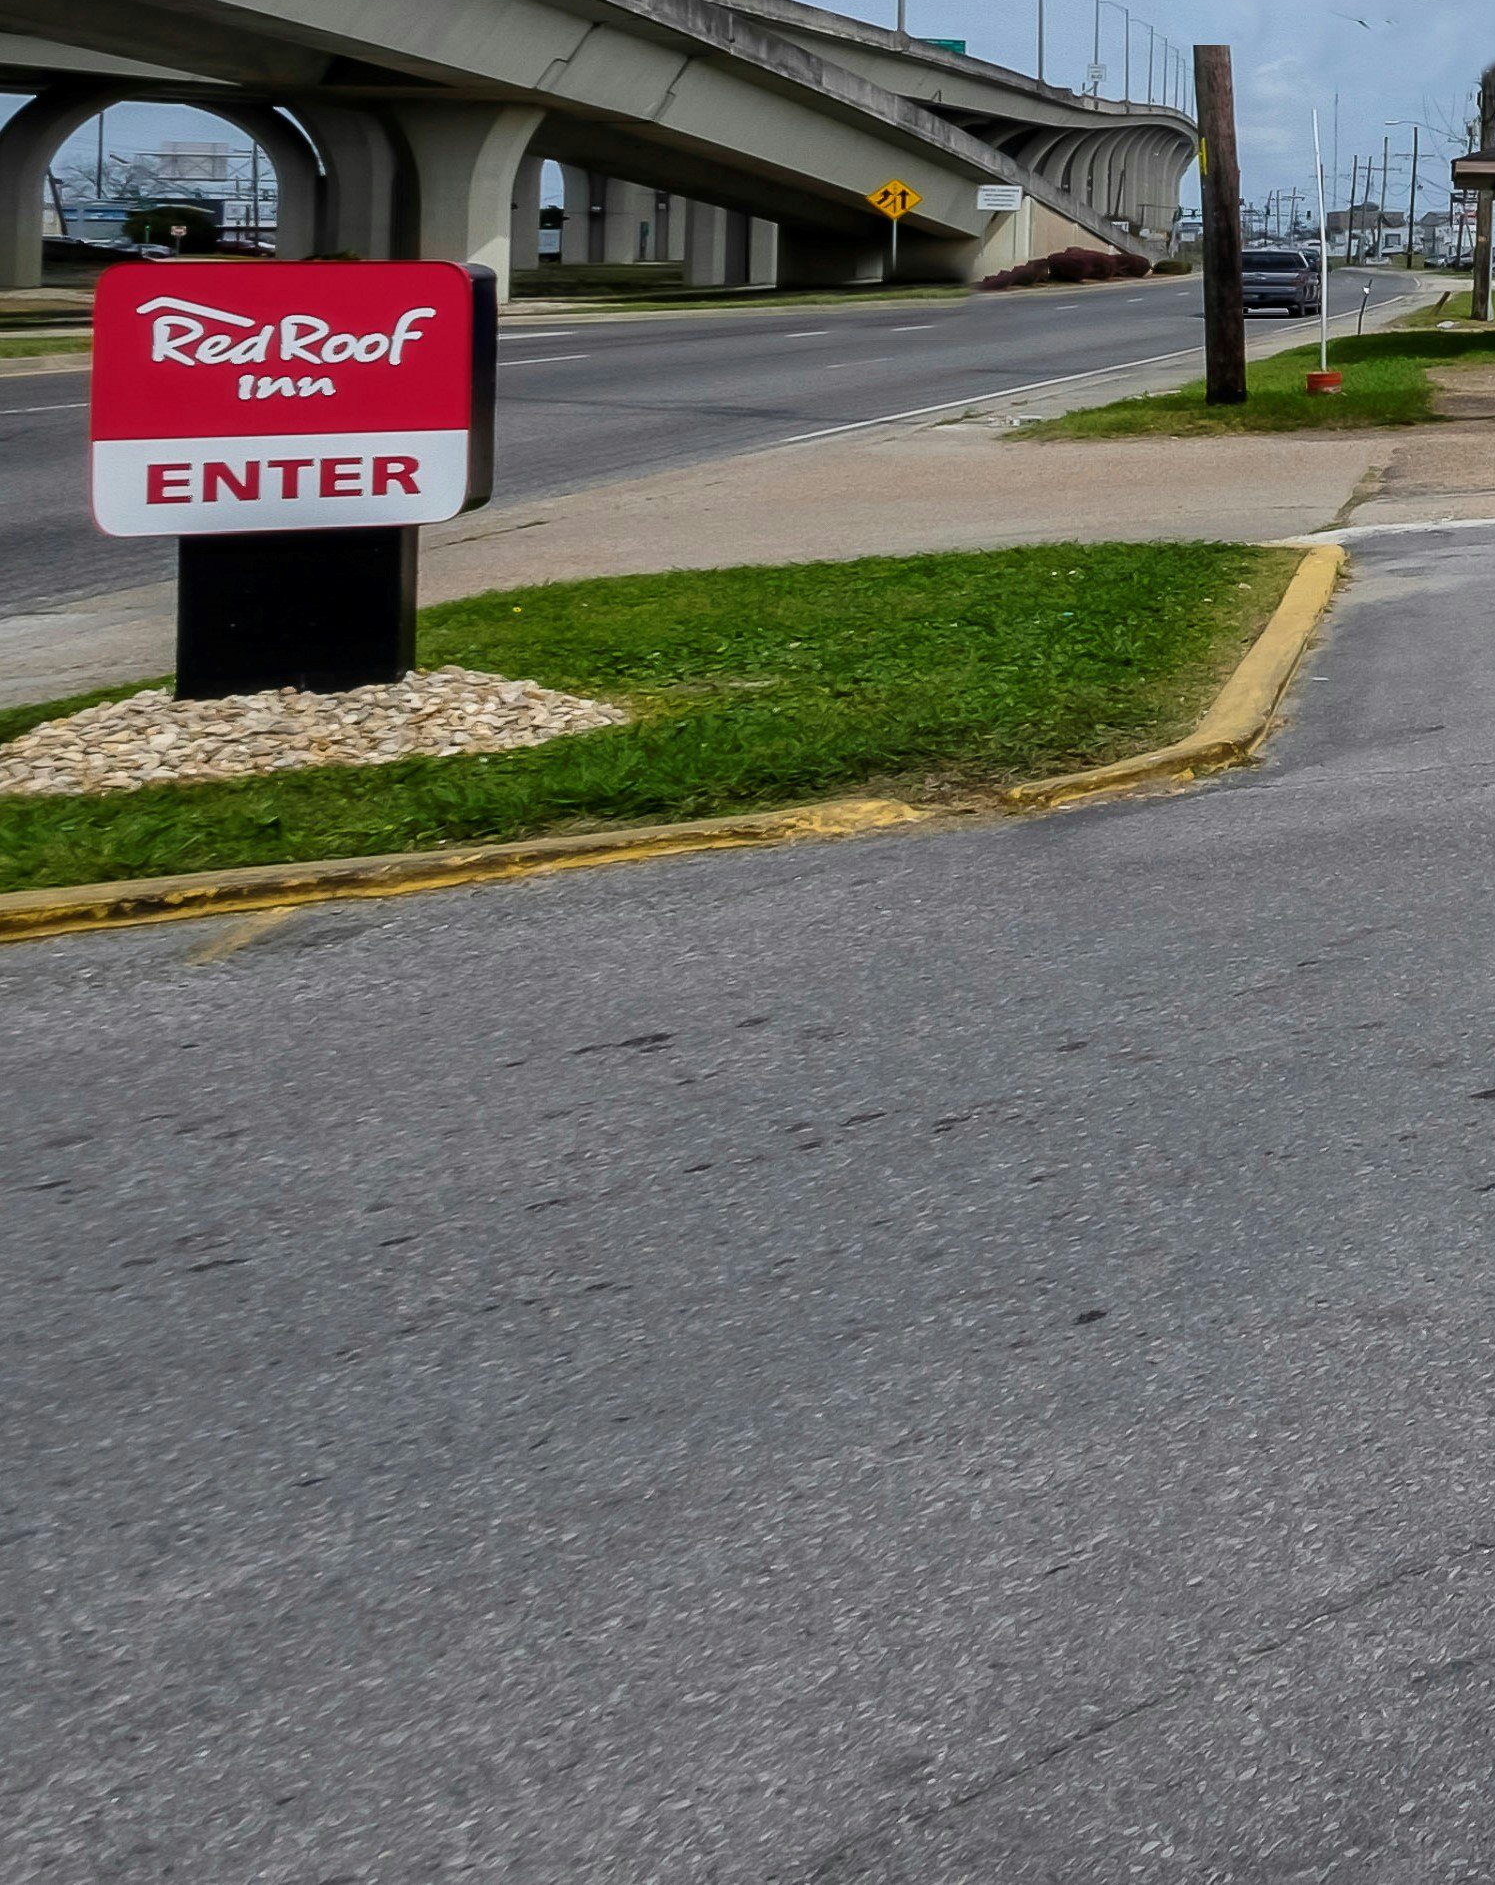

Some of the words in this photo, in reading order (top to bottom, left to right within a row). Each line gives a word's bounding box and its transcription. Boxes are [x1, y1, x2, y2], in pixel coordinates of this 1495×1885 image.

[151, 315, 274, 366] Red
[279, 308, 437, 366] Roof
[146, 455, 421, 505] ENTER
